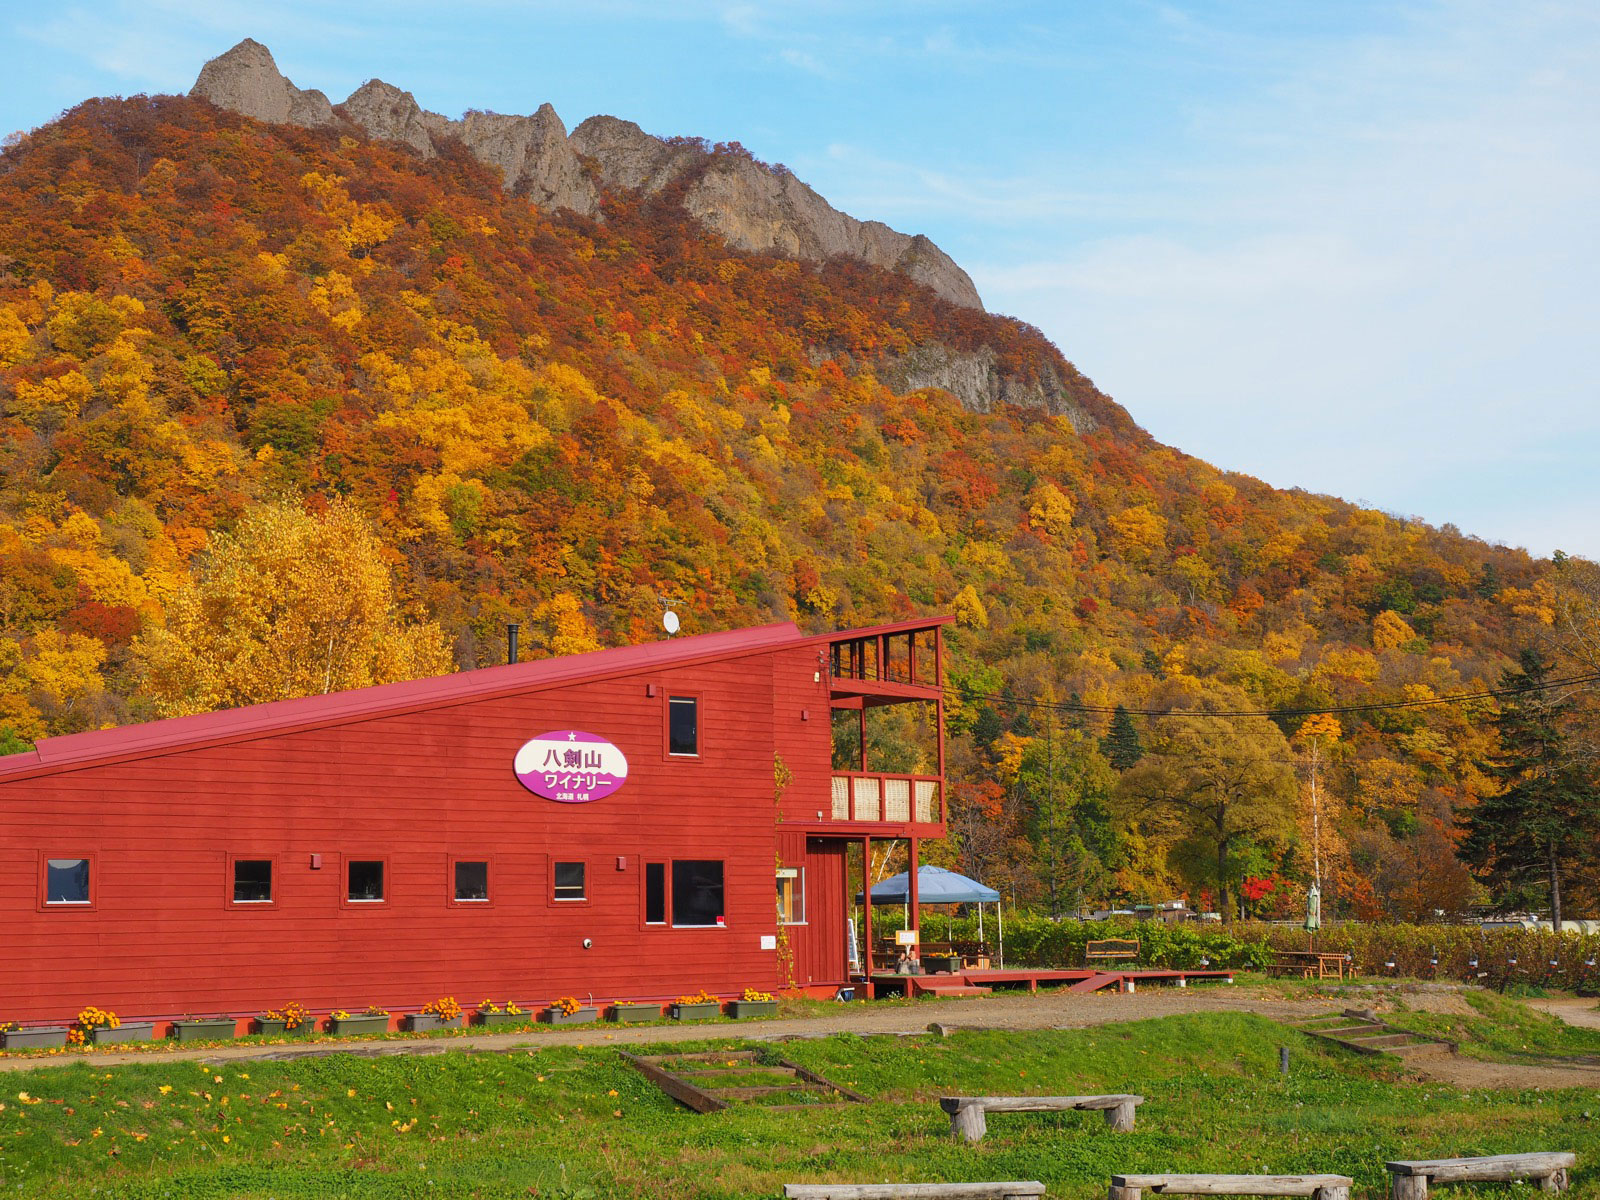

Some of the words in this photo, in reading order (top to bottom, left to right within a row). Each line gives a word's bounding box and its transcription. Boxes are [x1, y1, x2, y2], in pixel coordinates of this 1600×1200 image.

[543, 748, 602, 769] 八剣山
[544, 774, 612, 790] ワイナリー
